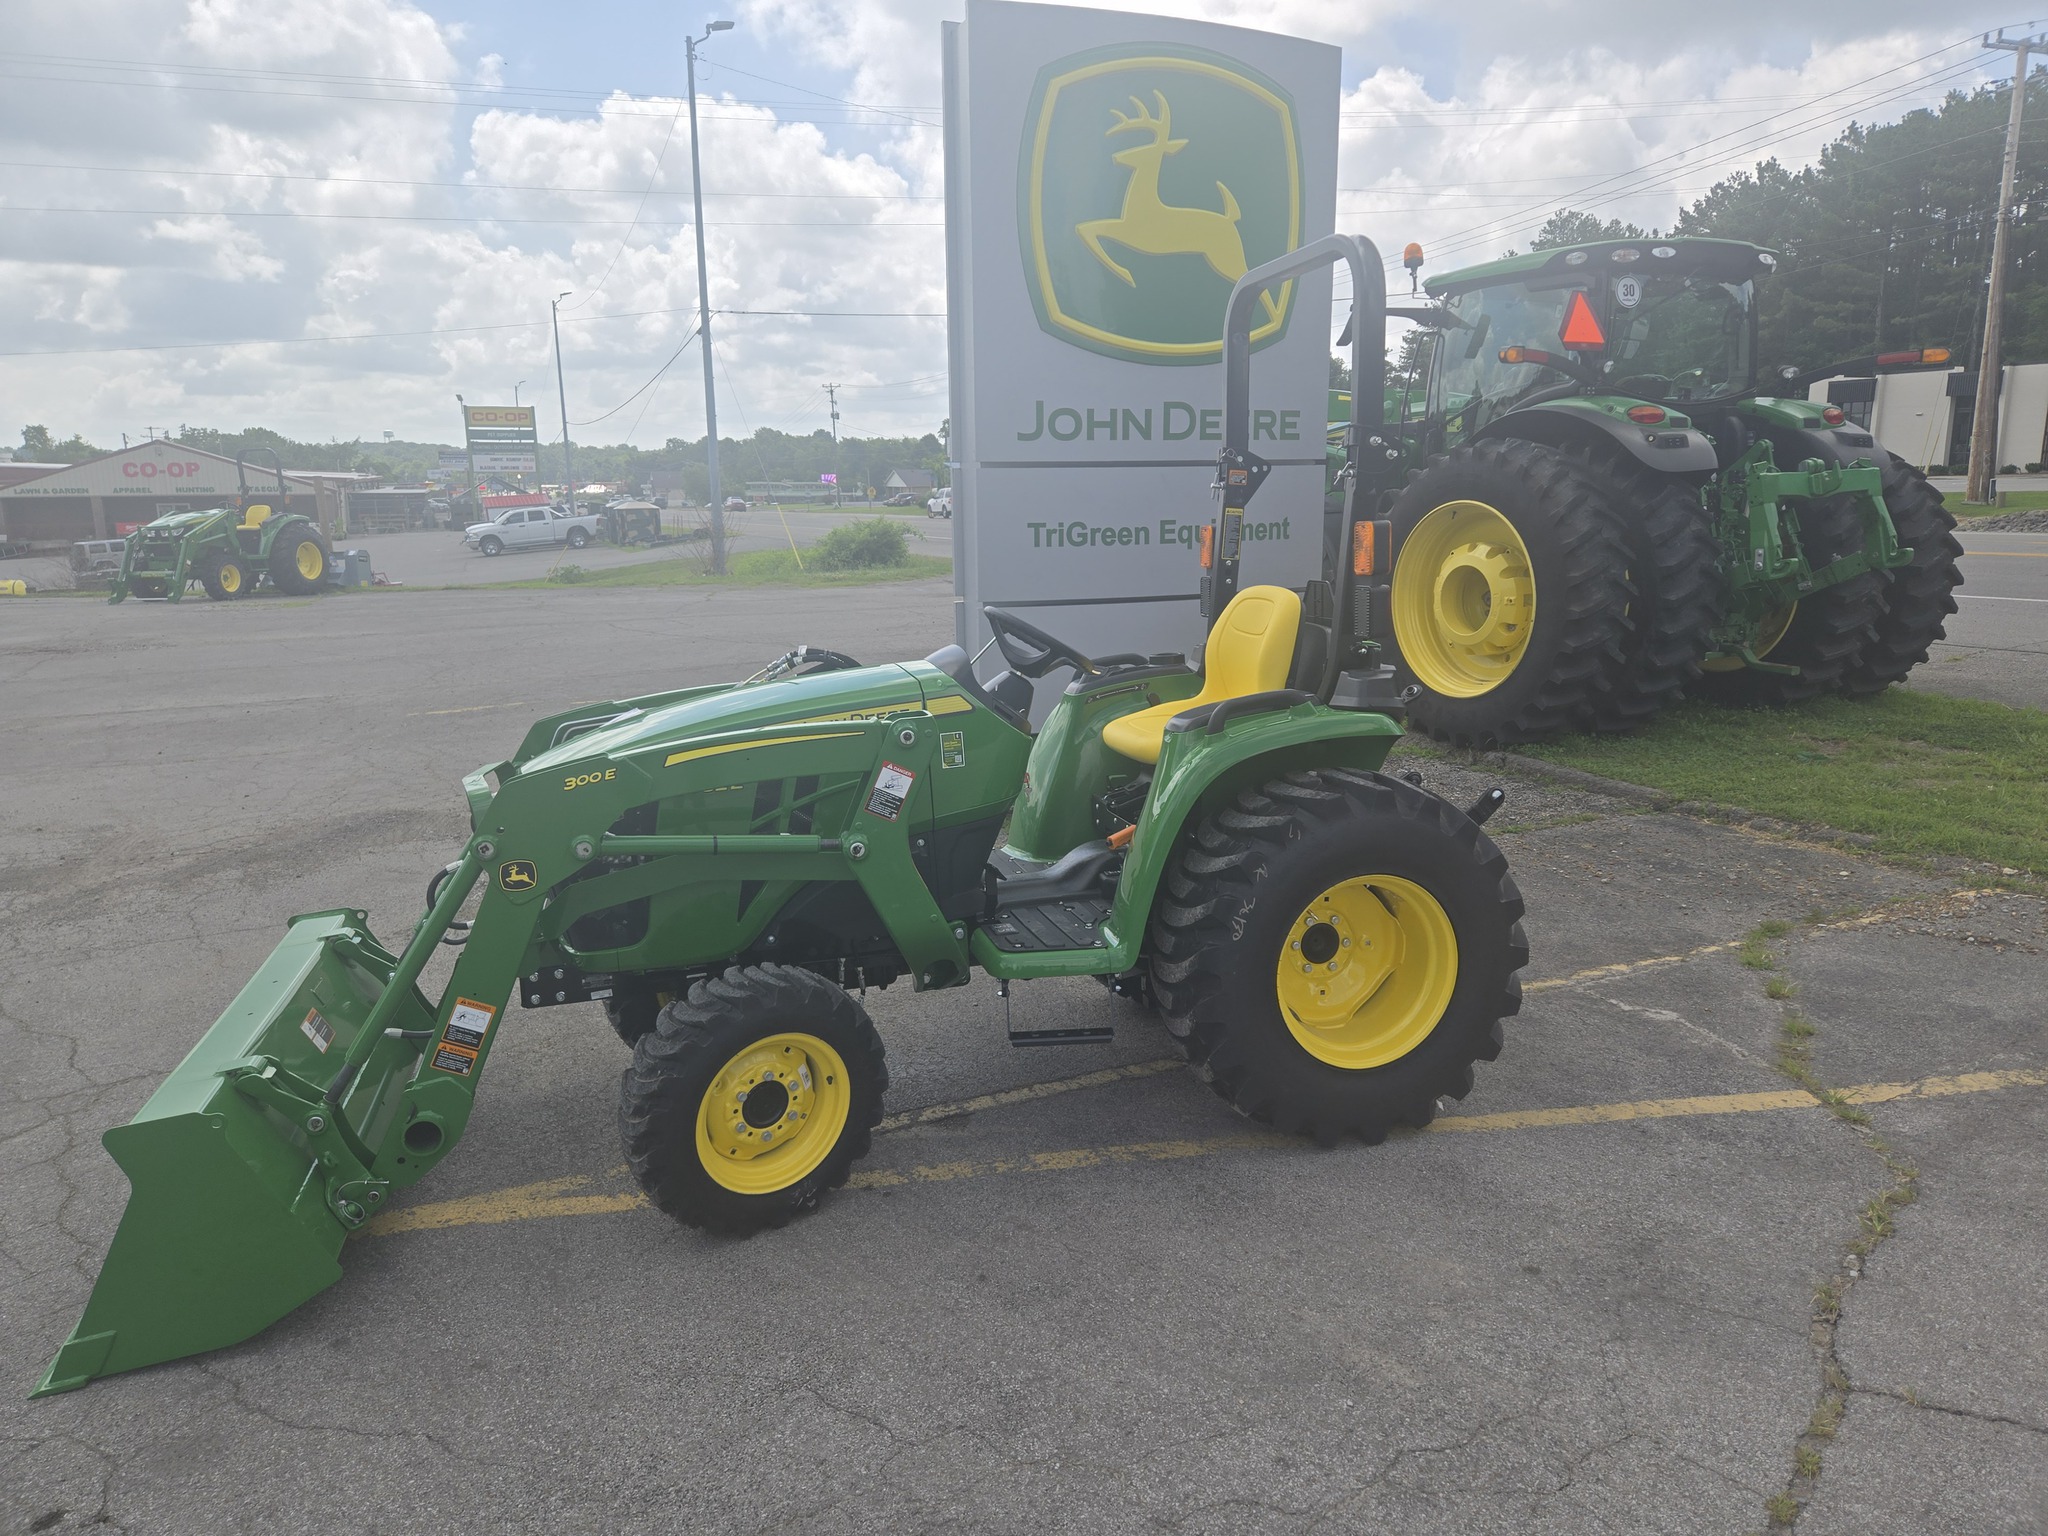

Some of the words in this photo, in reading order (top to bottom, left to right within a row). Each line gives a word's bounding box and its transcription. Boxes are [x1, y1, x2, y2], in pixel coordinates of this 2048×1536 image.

[1622, 283, 1635, 297] 30
[472, 412, 529, 422] CO-OP
[1017, 400, 1152, 441] JOHN
[1163, 401, 1300, 441] DERE
[122, 461, 200, 478] CO-OP
[13, 487, 41, 495] LAWN
[51, 487, 89, 495] GARDEN
[112, 486, 152, 494] APPAREL
[175, 486, 215, 494] HUNTING
[1027, 521, 1150, 548] TriGreen
[893, 766, 912, 777] DANGER
[466, 1000, 492, 1012] WARNING
[448, 1047, 473, 1057] WARNING
